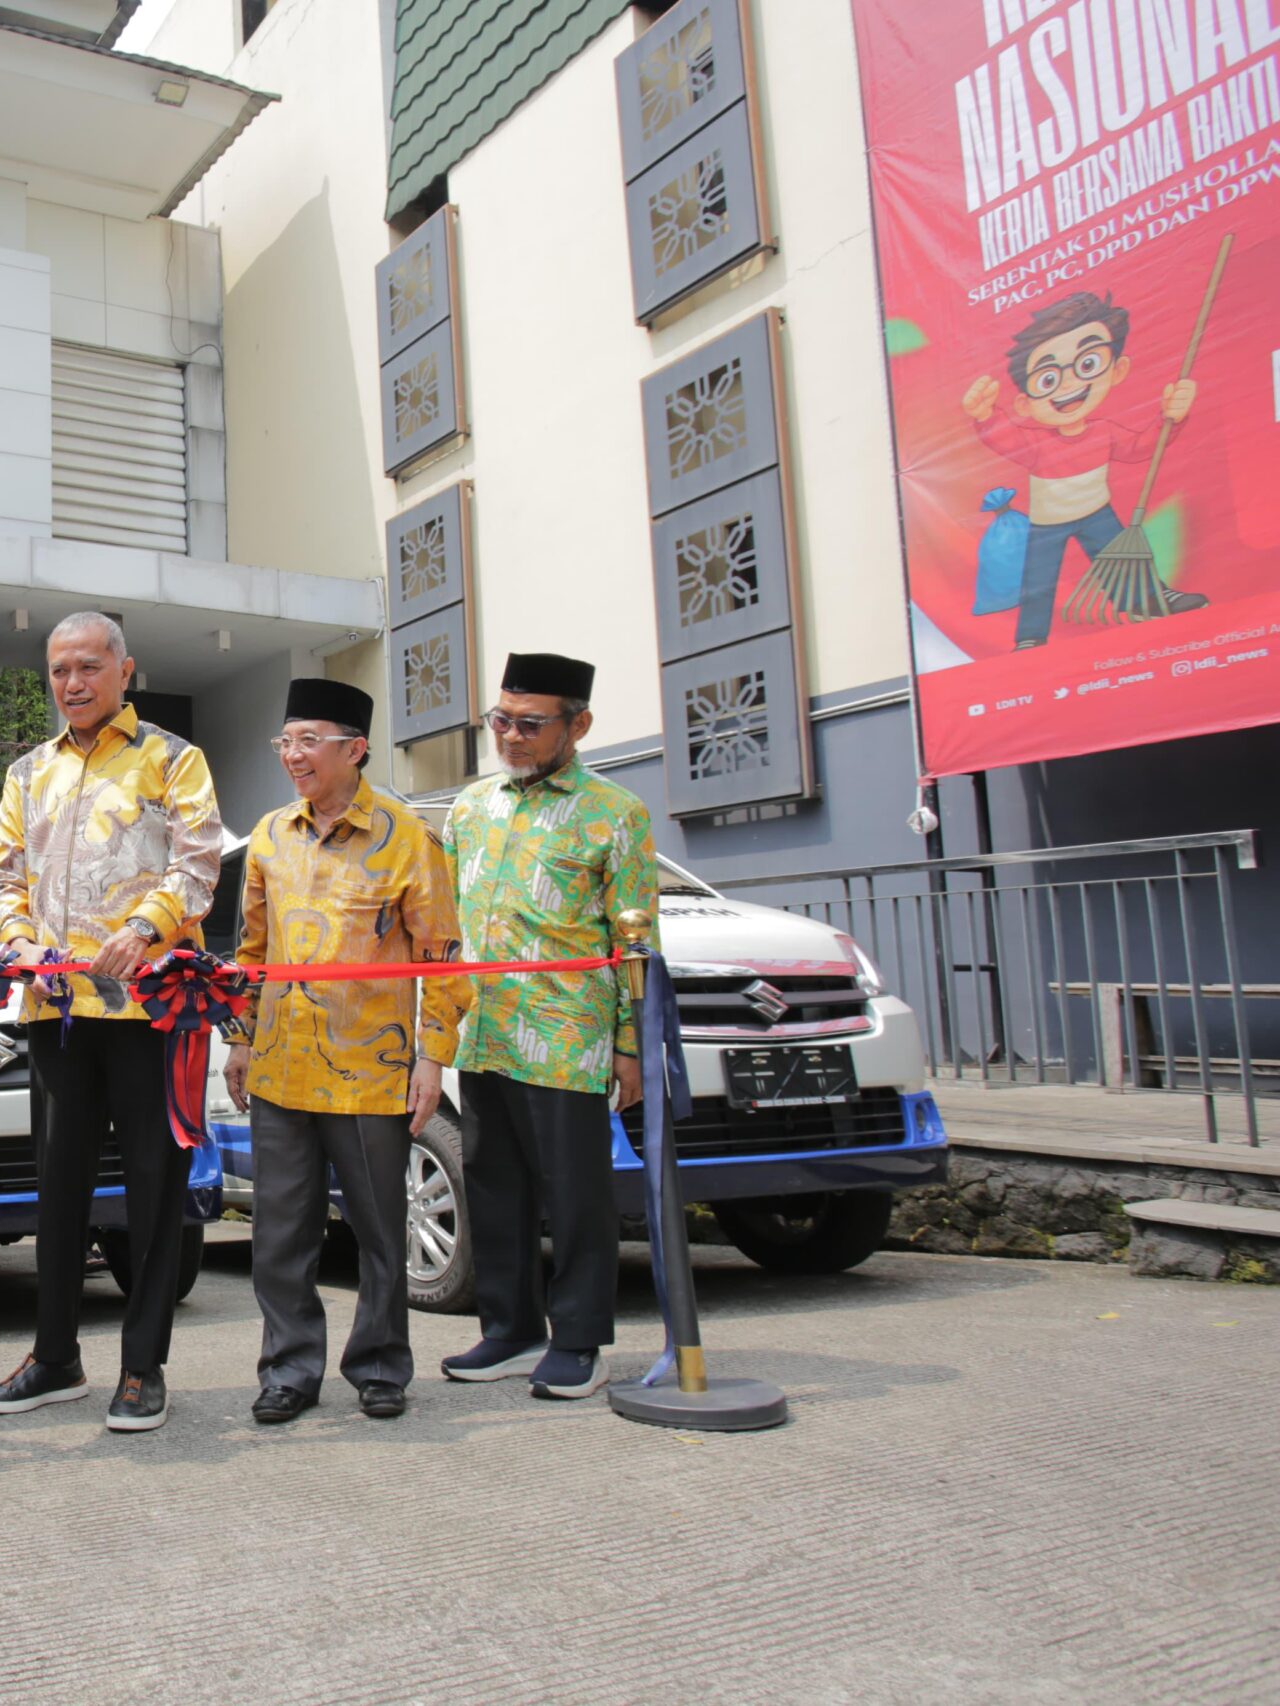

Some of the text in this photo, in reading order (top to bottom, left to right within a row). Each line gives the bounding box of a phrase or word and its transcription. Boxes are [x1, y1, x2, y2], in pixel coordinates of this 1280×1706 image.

[967, 138, 1280, 306] SERENTAK DI MUSHOLLA
[978, 54, 1280, 272] KERJA BERSAMA BAKTI
[993, 163, 1280, 315] PAC, PC, DPD DAN DPW
[1017, 694, 1034, 706] TV
[1077, 671, 1155, 696] @ldii_news
[1194, 648, 1269, 670] ldii_news
[1093, 655, 1134, 671] Follow
[1148, 639, 1212, 660] Subcribe
[1213, 626, 1266, 646] Official
